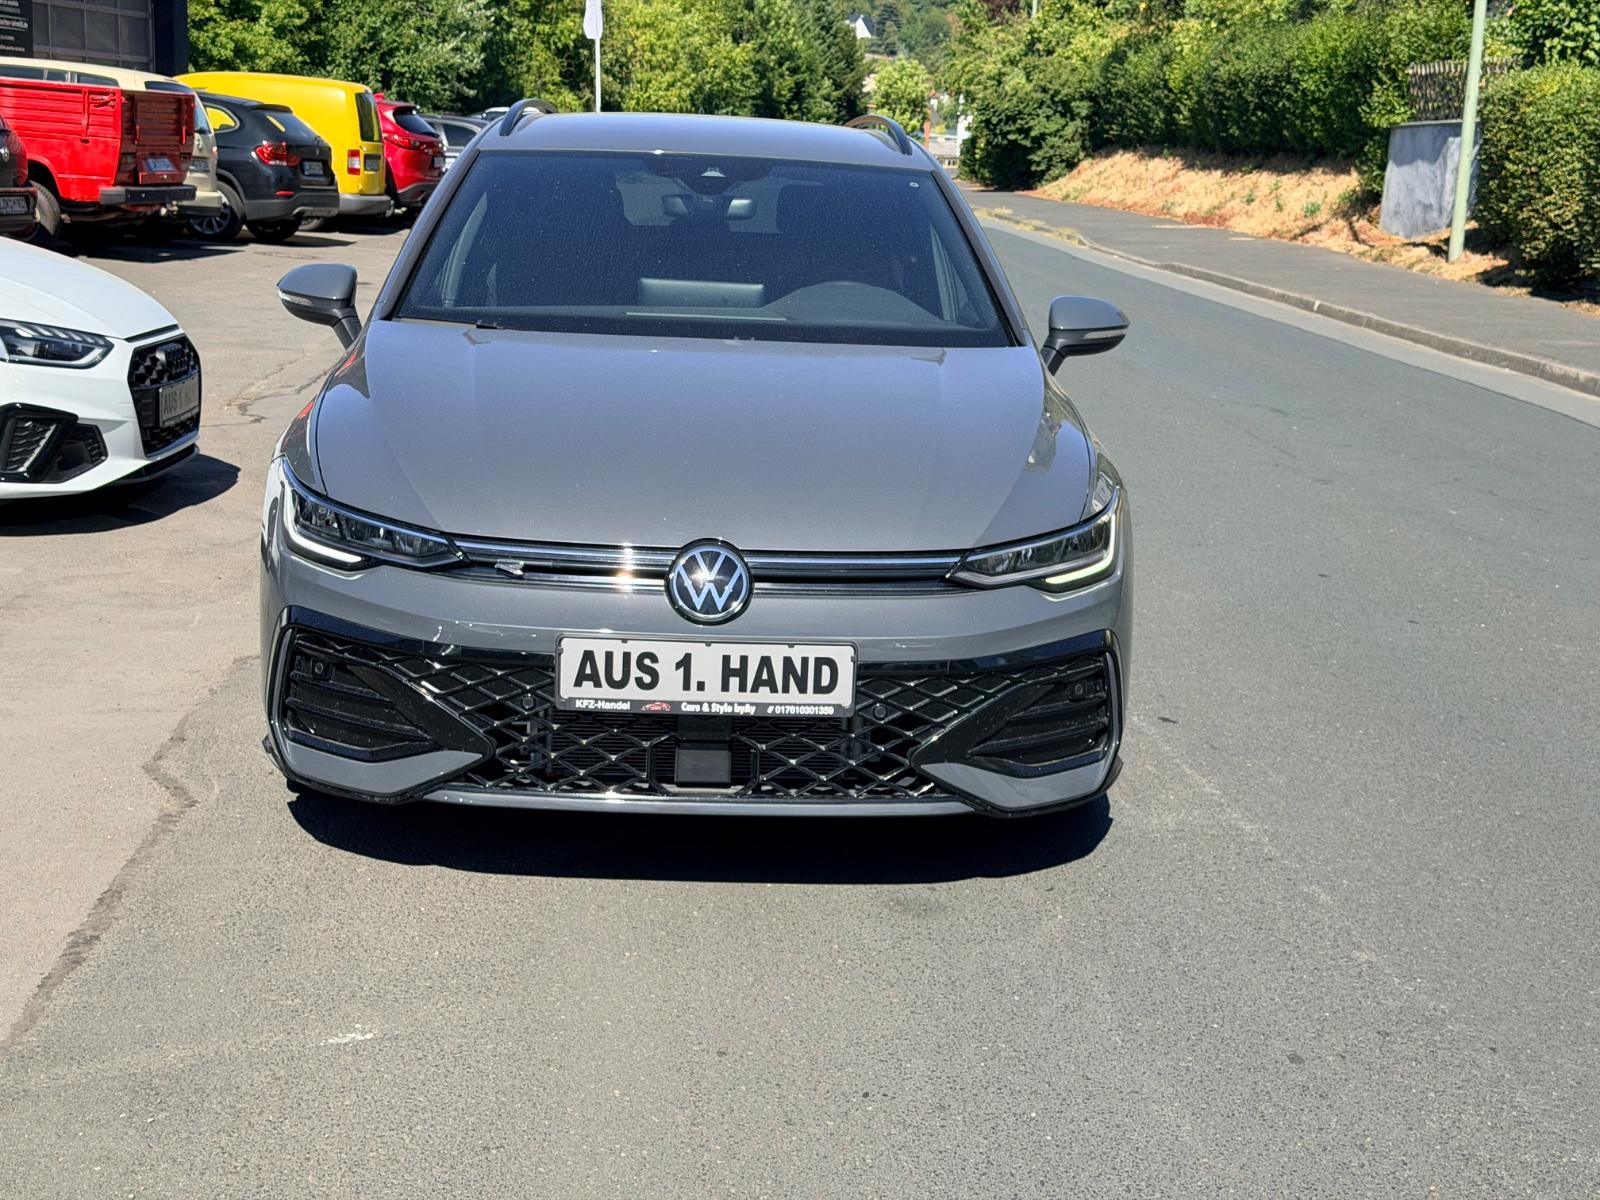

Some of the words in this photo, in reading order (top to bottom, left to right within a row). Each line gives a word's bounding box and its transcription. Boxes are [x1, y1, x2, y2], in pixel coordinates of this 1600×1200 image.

[573, 649, 660, 691] AUS
[674, 652, 706, 692] 1.
[720, 654, 839, 695] HAND
[575, 699, 630, 710] KFZ-Handel
[681, 702, 701, 712] Cars
[702, 702, 710, 713] &
[711, 702, 733, 714] Style
